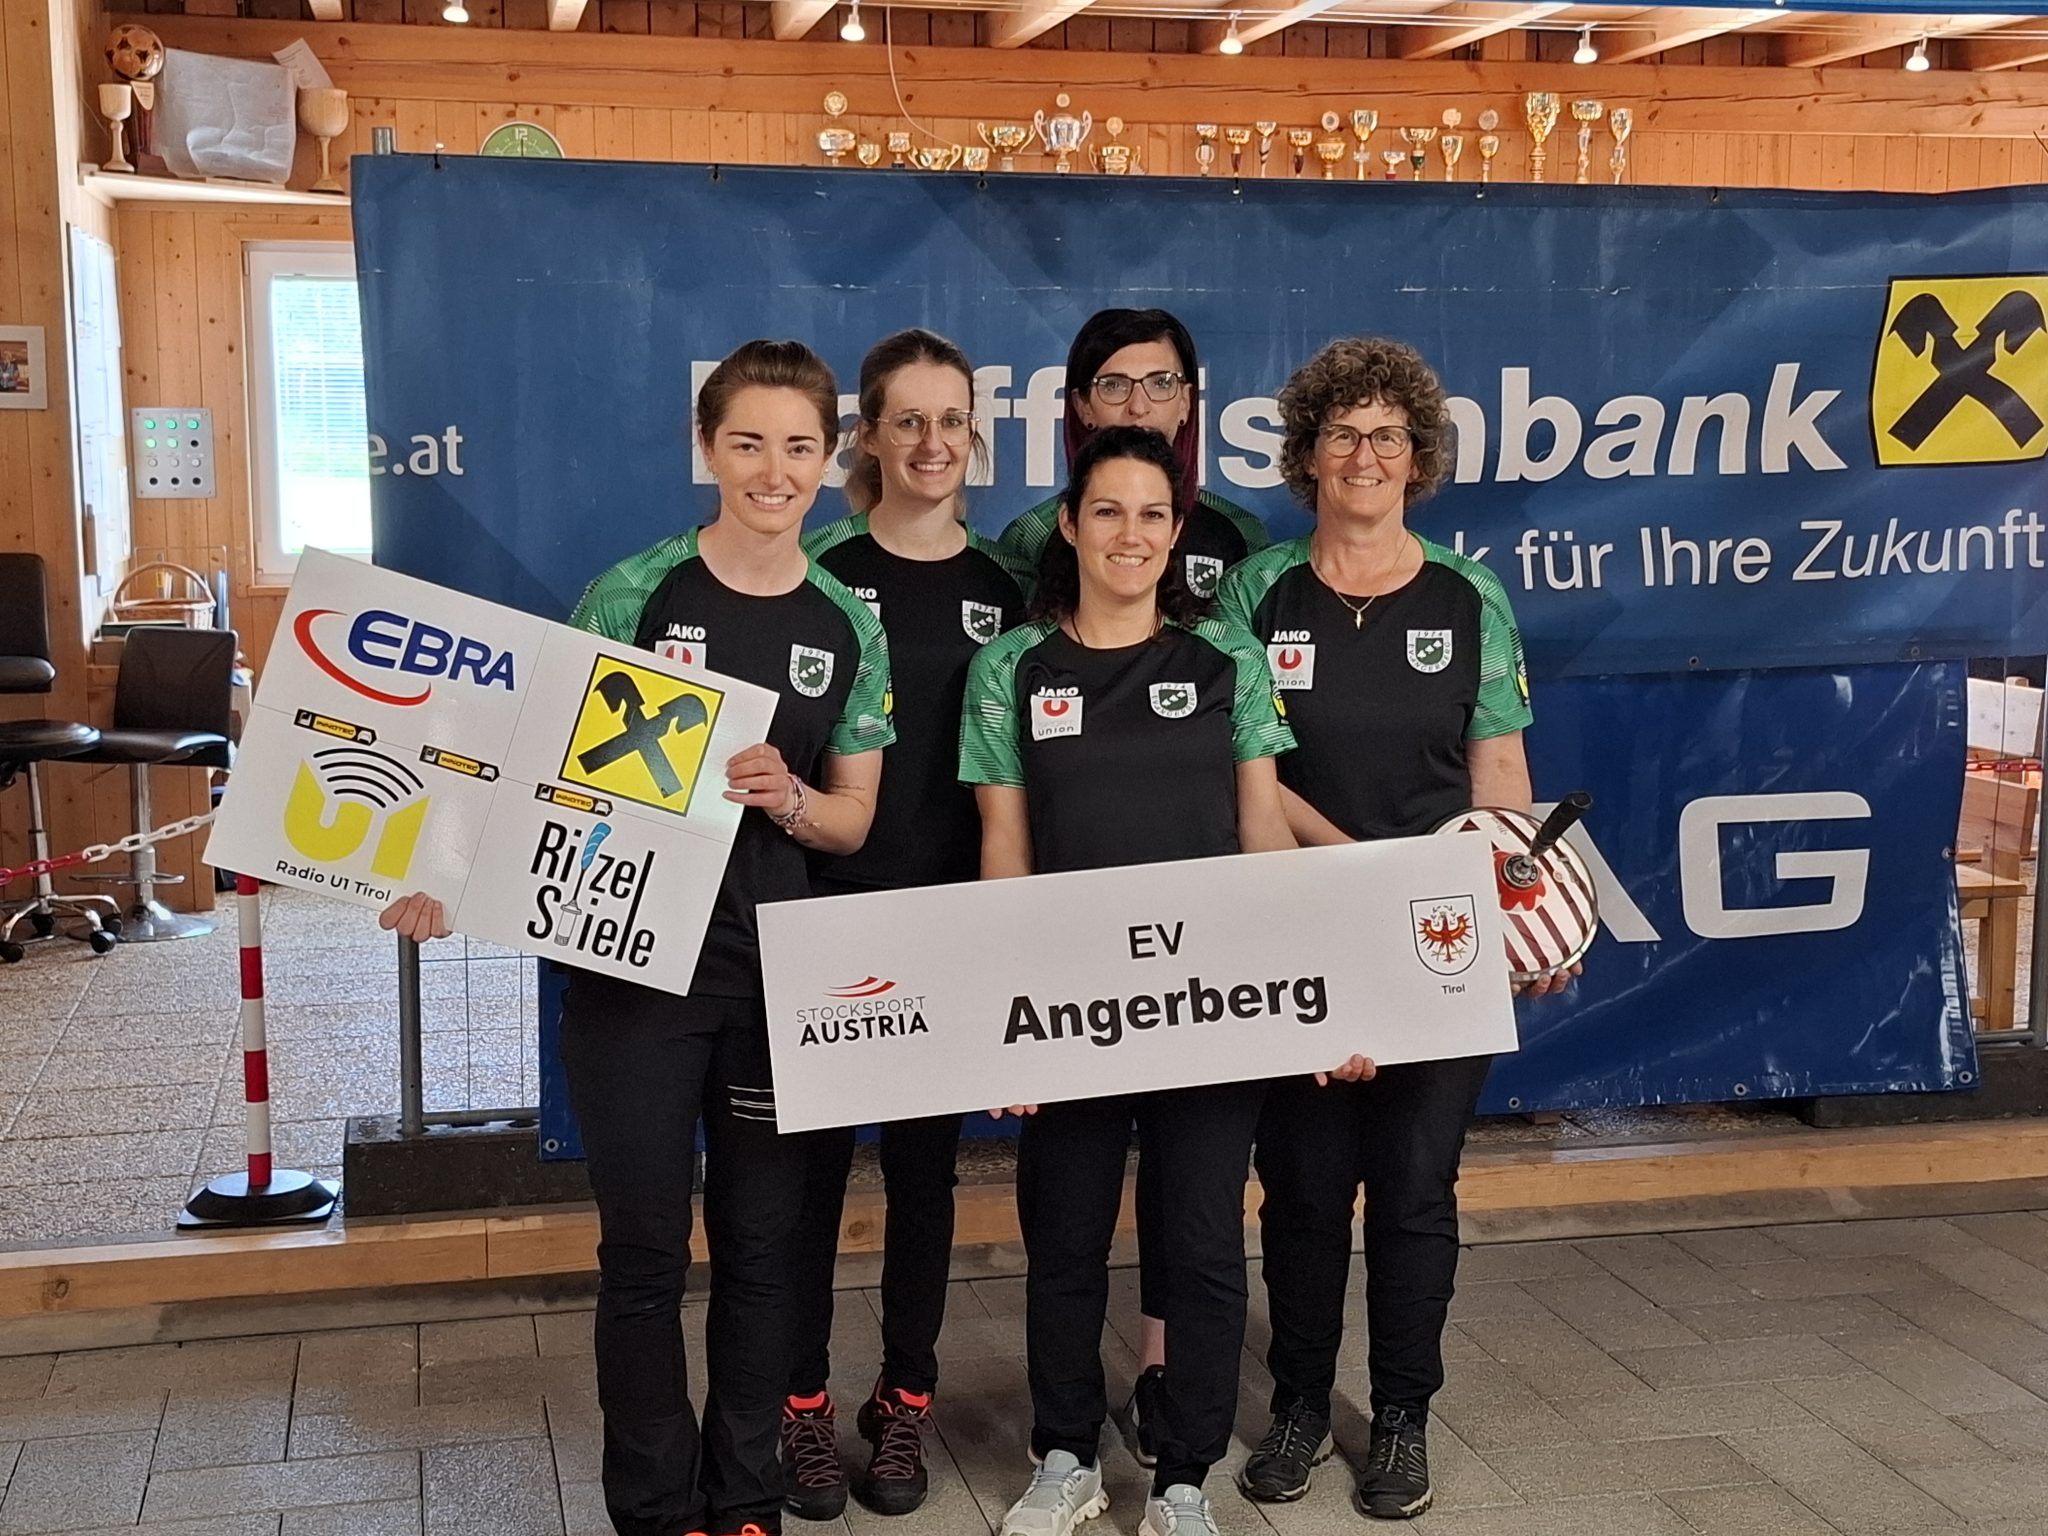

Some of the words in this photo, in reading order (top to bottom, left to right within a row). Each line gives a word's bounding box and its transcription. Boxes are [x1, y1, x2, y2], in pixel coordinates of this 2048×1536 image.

[1515, 529, 1613, 590] für
[1641, 526, 1772, 586] Ihre
[1792, 509, 2046, 581] Zukunft
[665, 622, 706, 641] JAKO
[1271, 630, 1311, 643] JAKO
[348, 609, 515, 692] EBRA
[1037, 686, 1079, 698] JAKO
[315, 719, 355, 735] INNOTEC
[1038, 726, 1074, 736] union
[555, 793, 592, 807] INNOTEC
[275, 860, 325, 883] Radio
[330, 875, 350, 890] U1
[354, 881, 391, 902] Tirol
[1128, 921, 1184, 960] EV
[1441, 984, 1465, 994] Tirol
[796, 996, 926, 1023] STOCKSPORT
[1003, 976, 1328, 1047] Angerberg
[799, 1011, 929, 1046] AUSTRIA
